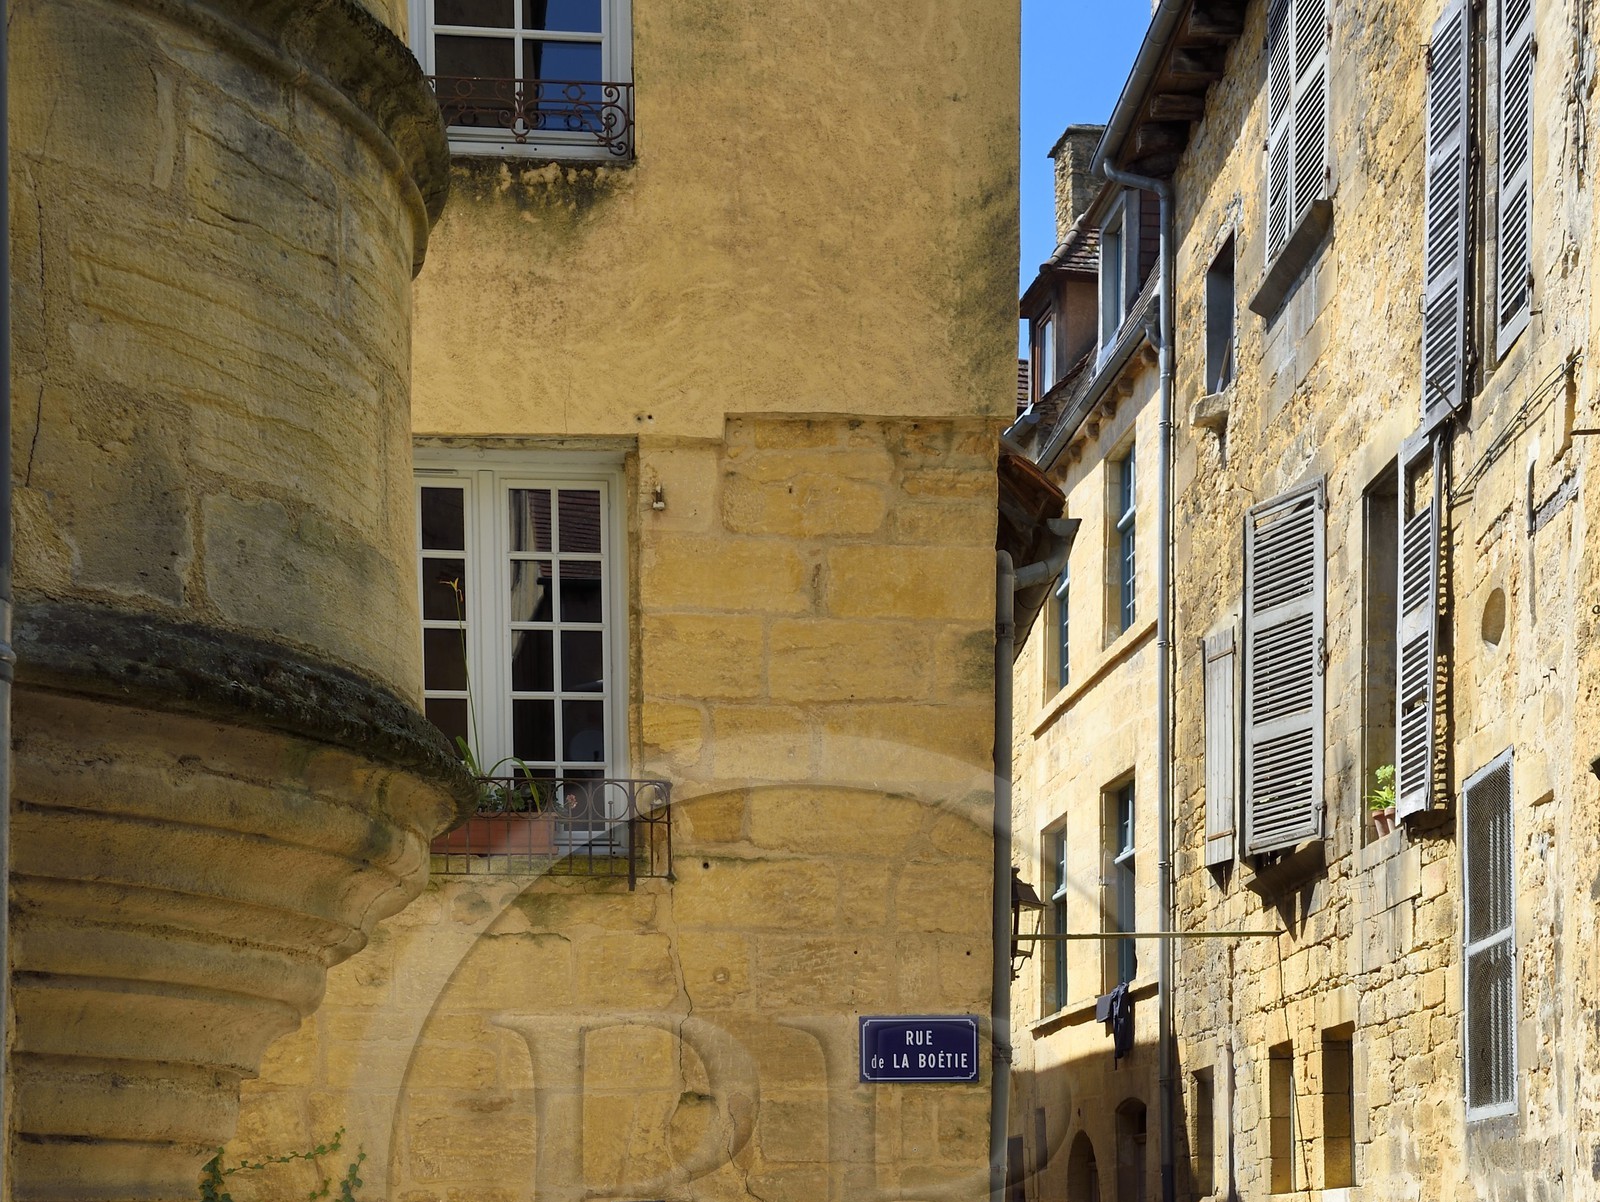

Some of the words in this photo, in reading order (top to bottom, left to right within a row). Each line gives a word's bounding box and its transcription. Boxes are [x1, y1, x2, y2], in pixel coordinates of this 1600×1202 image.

[906, 1030, 933, 1046] RUE
[871, 1054, 885, 1069] de
[893, 1053, 910, 1069] LA
[918, 1050, 968, 1069] BOÉTIE
